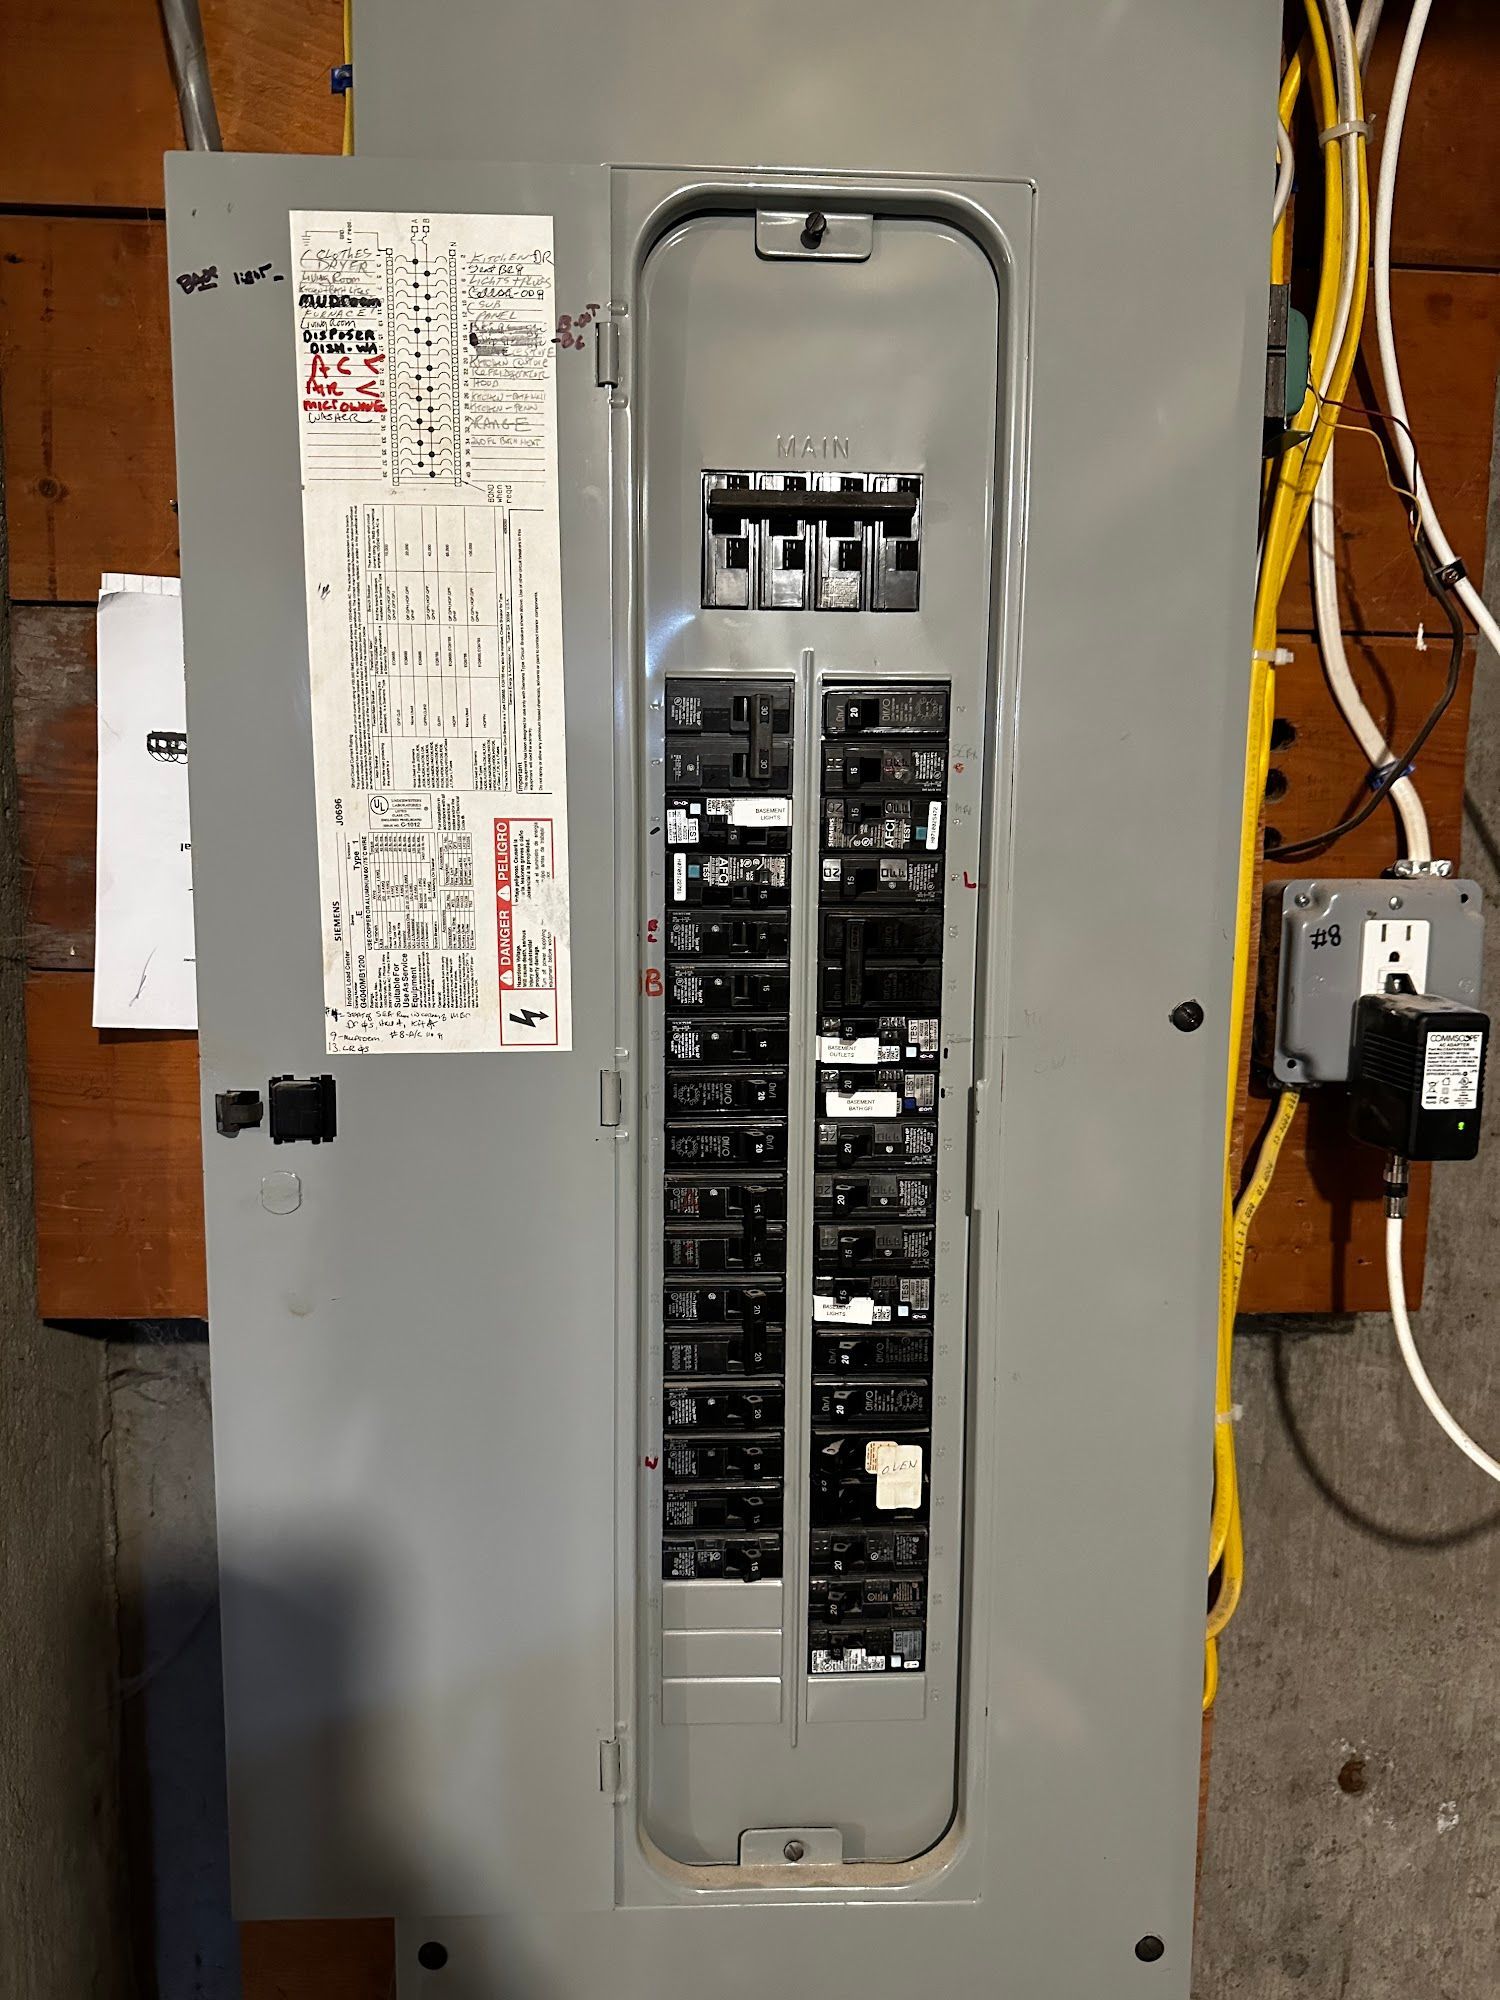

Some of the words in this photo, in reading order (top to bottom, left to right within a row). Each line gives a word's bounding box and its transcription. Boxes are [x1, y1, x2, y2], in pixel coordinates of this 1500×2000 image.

[318, 259, 372, 276] DRYER
[776, 433, 849, 458] MAIN
[760, 705, 769, 716] 30
[850, 707, 858, 718] 20
[760, 759, 768, 769] 30
[334, 798, 344, 826] J0696
[852, 808, 859, 817] 15
[730, 830, 738, 840] 15
[885, 820, 896, 848] AFCI
[496, 822, 508, 880] PELIGRO
[353, 851, 362, 870] Type
[702, 864, 710, 881] TEST
[718, 857, 728, 886] AFCI
[848, 876, 855, 886] 15
[760, 890, 768, 899] 15
[332, 901, 342, 942] SIEMENS
[499, 910, 511, 966] DANGER
[760, 932, 766, 940] 15
[1309, 924, 1342, 950] #8
[392, 964, 400, 976] For
[402, 982, 408, 992] As
[410, 966, 420, 1008] Equipment
[646, 968, 663, 997] B
[846, 1026, 852, 1037] 15
[910, 1021, 918, 1042] TEST
[1430, 1034, 1480, 1042] COMMSCOPE
[760, 1040, 767, 1048] 15
[844, 1080, 852, 1088] 20
[906, 1076, 914, 1096] TEST
[758, 1092, 765, 1100] 20
[756, 1144, 763, 1154] 20
[844, 1143, 852, 1153] 20
[837, 1194, 845, 1205] 20
[754, 1204, 761, 1213] 15
[754, 1253, 761, 1262] 15
[846, 1250, 852, 1258] 15
[840, 1290, 847, 1300] 15
[754, 1305, 760, 1315] 20
[754, 1352, 762, 1362] 20
[841, 1355, 850, 1364] 20
[754, 1409, 762, 1419] 20
[836, 1405, 844, 1414] 20
[882, 1460, 918, 1474] OVEN
[752, 1562, 759, 1572] 15
[834, 1560, 842, 1570] 20
[830, 1604, 838, 1615] 20
